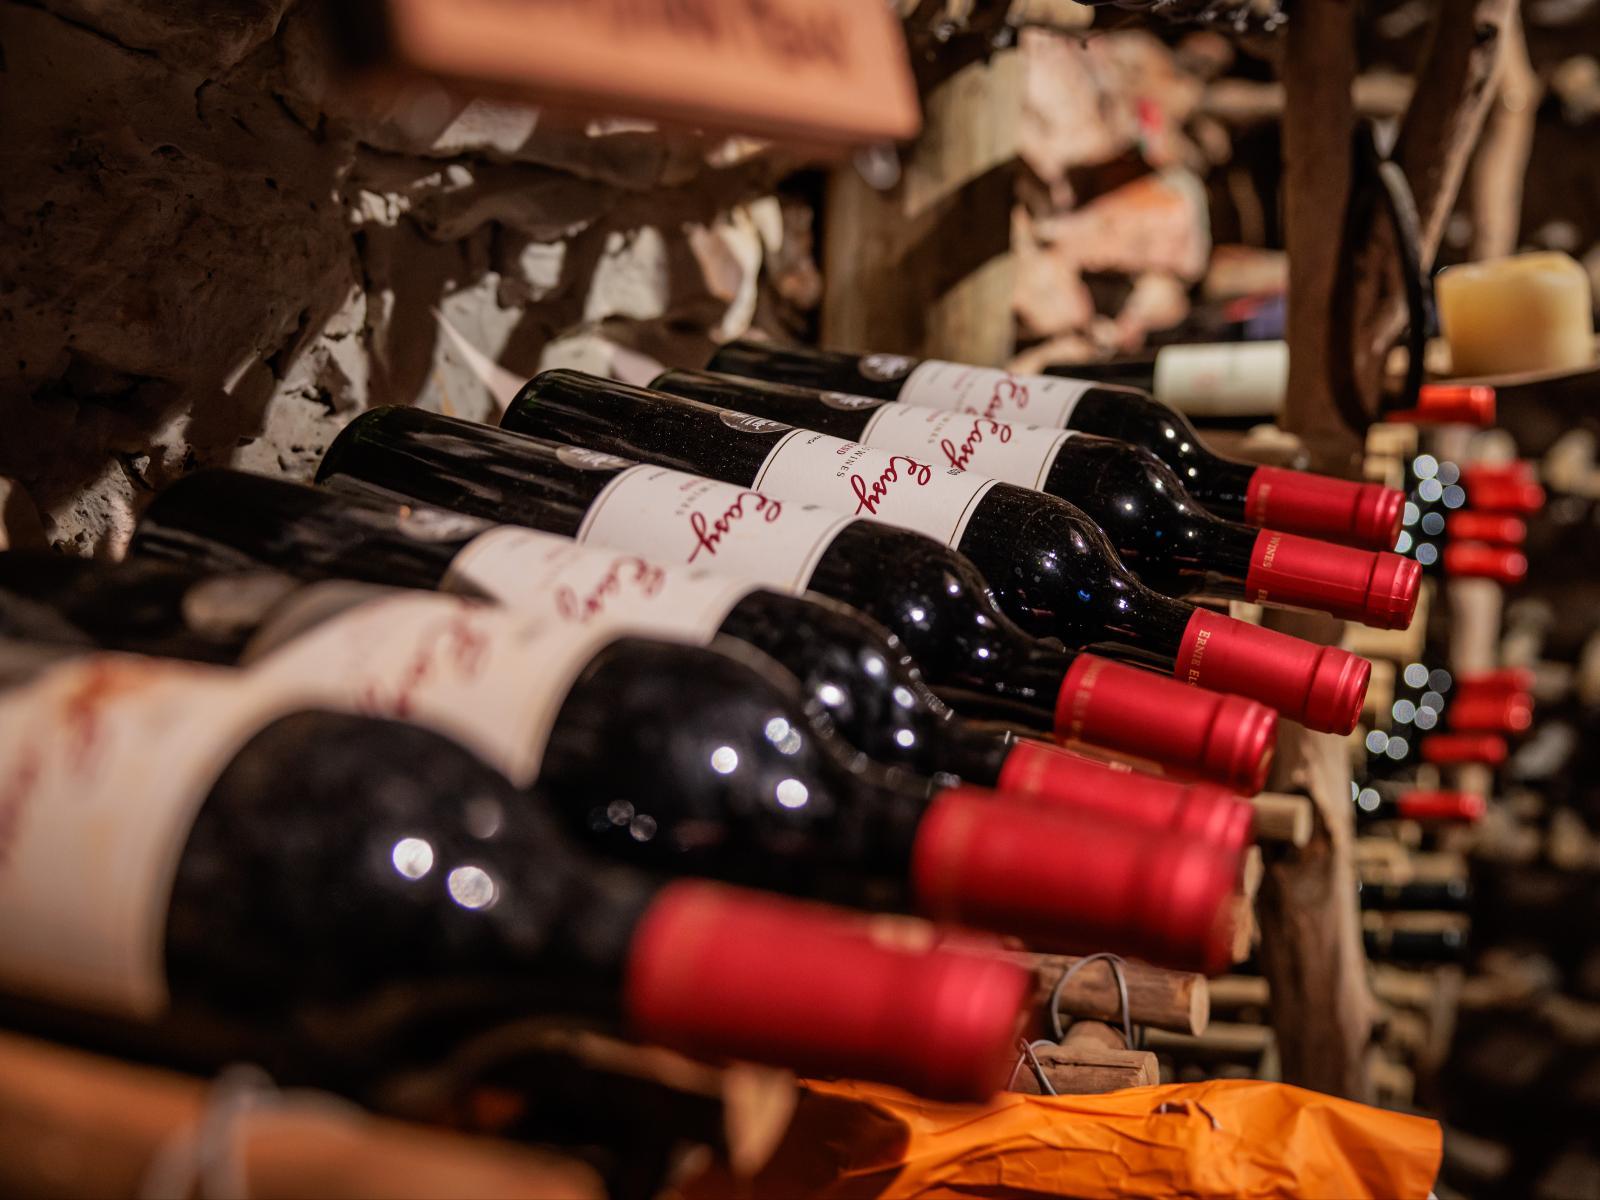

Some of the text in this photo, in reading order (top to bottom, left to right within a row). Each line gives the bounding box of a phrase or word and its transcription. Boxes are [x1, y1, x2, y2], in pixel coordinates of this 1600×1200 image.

[836, 450, 866, 477] WINES
[940, 418, 1012, 472] Easy
[850, 456, 932, 515] Easy
[687, 491, 782, 564] Easy
[1191, 629, 1211, 667] ERNIE
